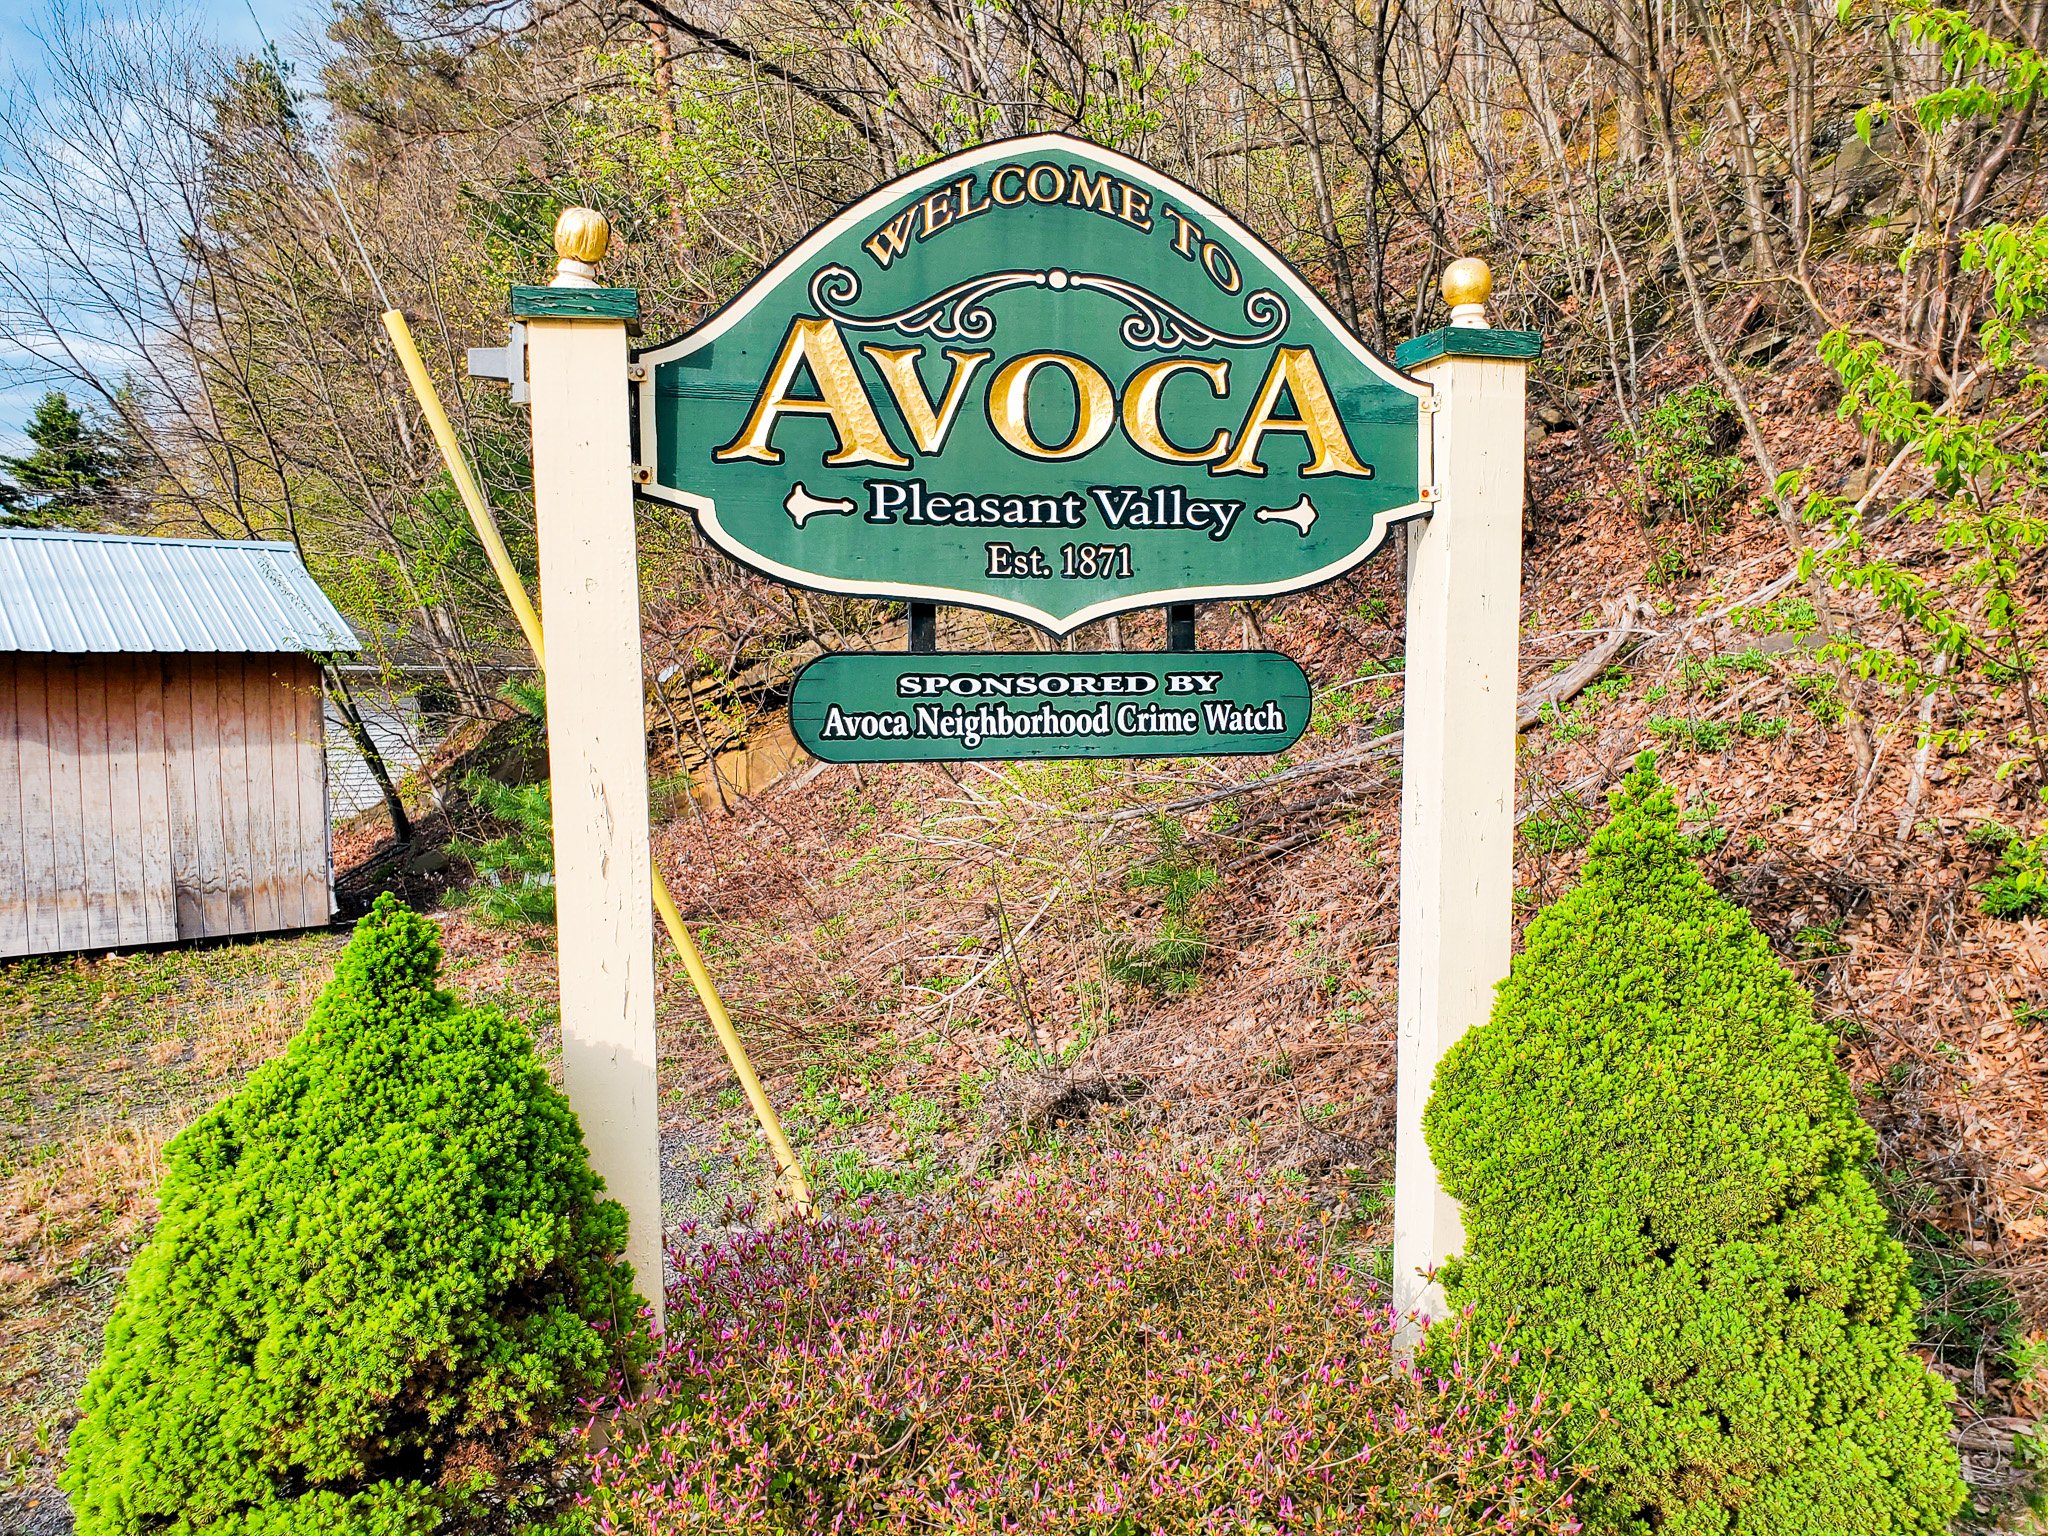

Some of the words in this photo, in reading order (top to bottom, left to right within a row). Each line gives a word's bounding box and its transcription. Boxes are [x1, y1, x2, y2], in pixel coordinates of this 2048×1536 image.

[866, 165, 1153, 267] WELCOME
[1165, 208, 1241, 293] TO
[715, 319, 1372, 477] AVOCA
[869, 483, 1081, 525] Pleasant
[1093, 487, 1241, 537] Valley
[988, 545, 1050, 576] Est.
[1063, 545, 1132, 576] 1871
[899, 675, 1156, 695] SPONSORED
[1167, 674, 1220, 692] BY
[823, 707, 908, 737] Avoca
[916, 705, 1109, 746] Neighborhood
[1116, 705, 1196, 733] Crime
[1203, 703, 1285, 731] Watch
